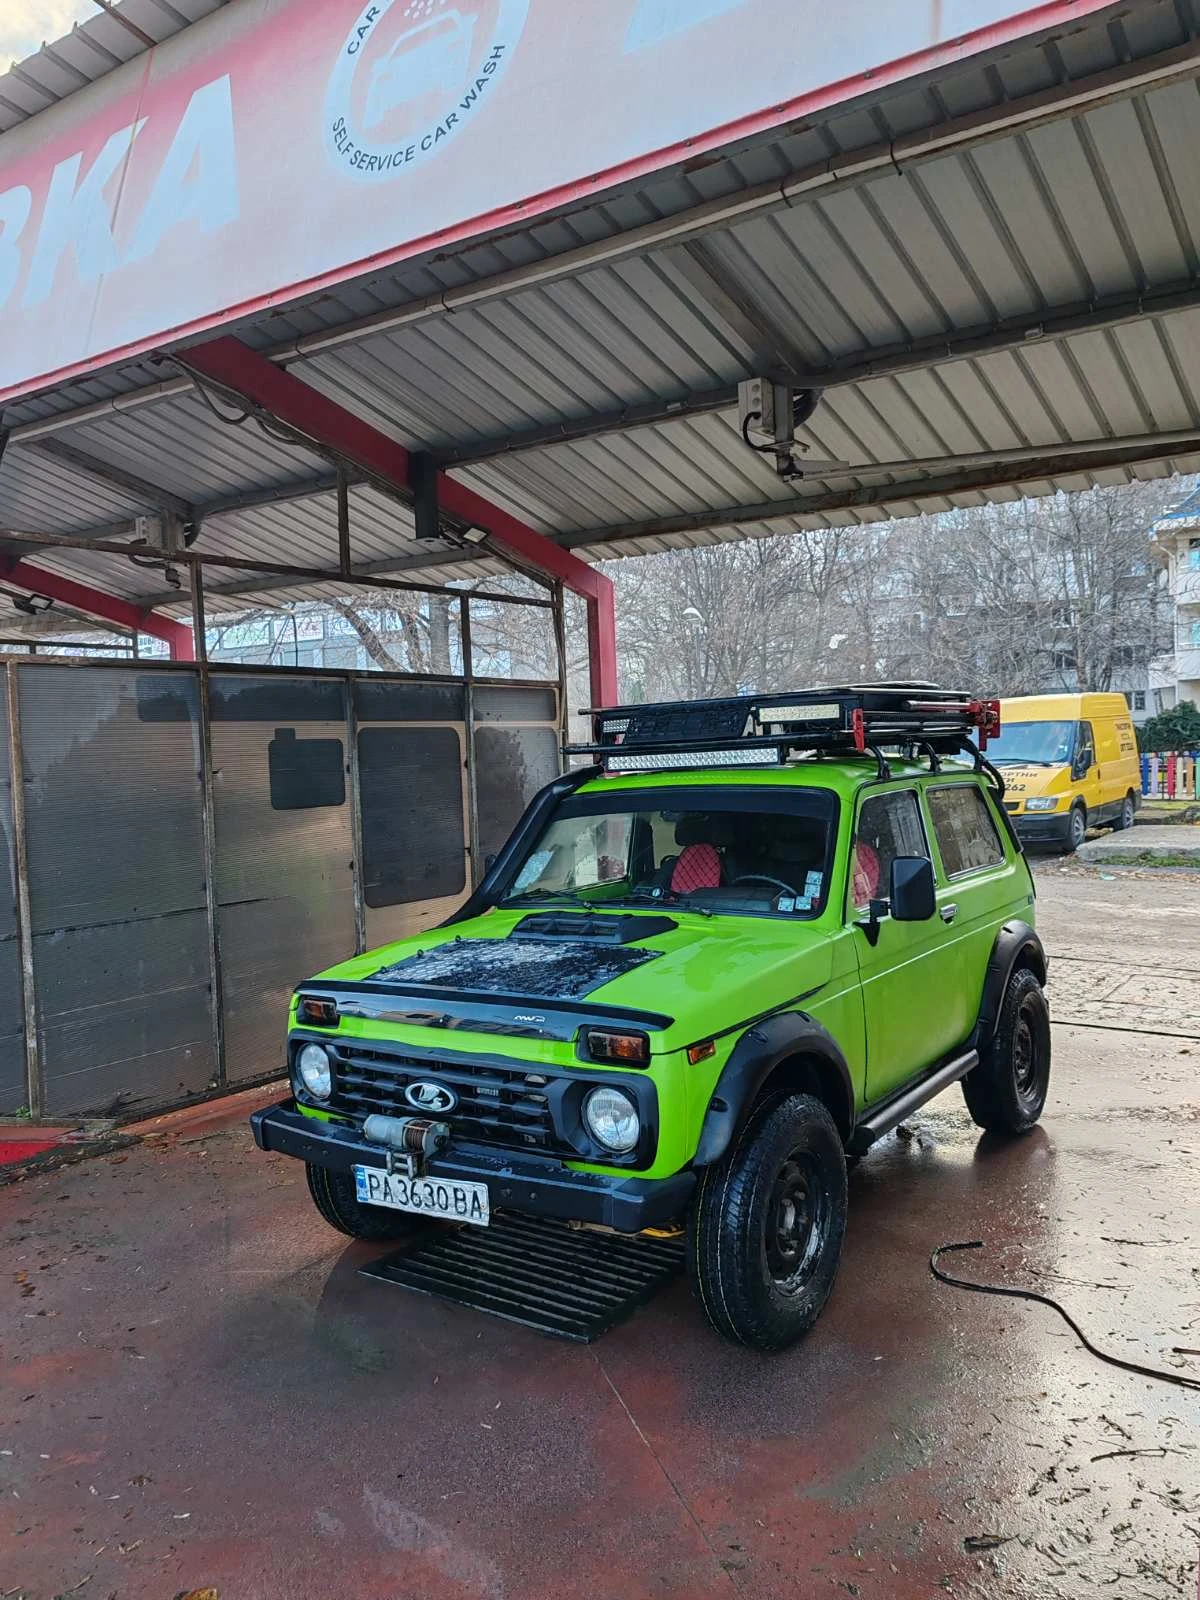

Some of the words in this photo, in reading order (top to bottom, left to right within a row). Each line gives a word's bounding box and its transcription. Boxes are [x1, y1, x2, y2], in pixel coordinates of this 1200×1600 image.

[347, 6, 380, 55] CAR
[332, 117, 354, 156] SELF
[350, 145, 416, 171] SERVICE
[420, 112, 459, 151] CAR
[459, 44, 506, 110] WASH
